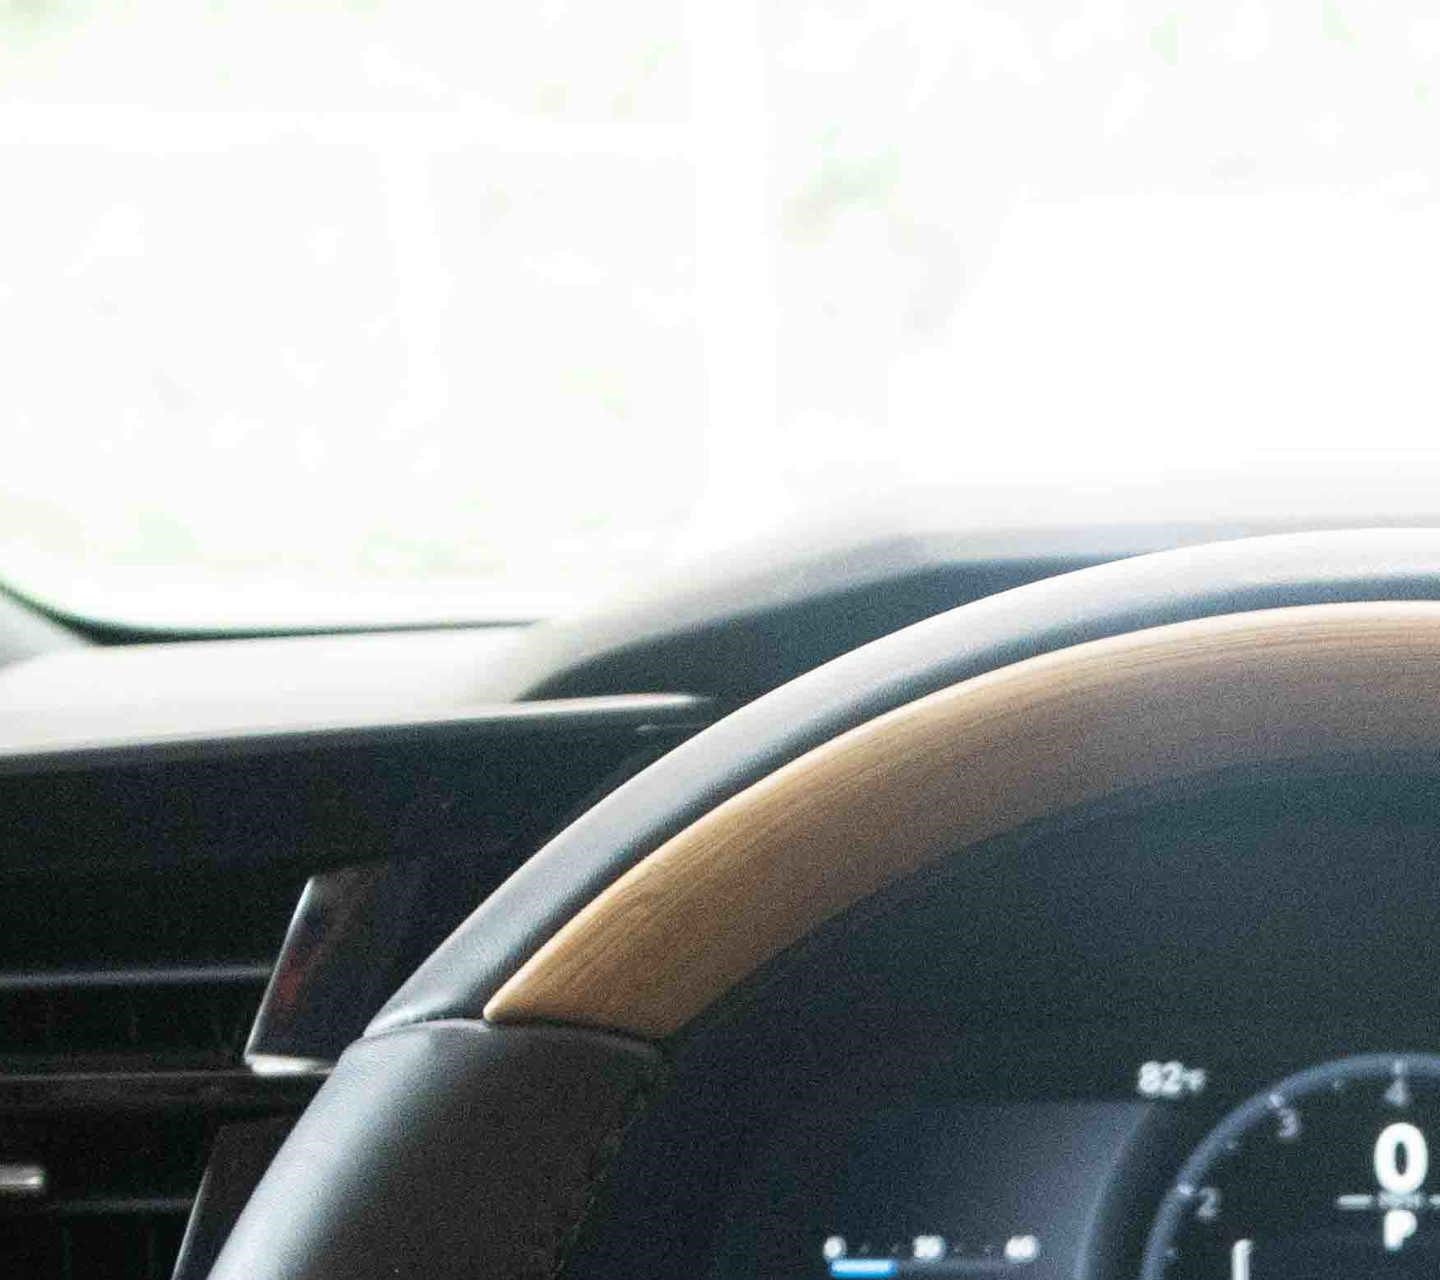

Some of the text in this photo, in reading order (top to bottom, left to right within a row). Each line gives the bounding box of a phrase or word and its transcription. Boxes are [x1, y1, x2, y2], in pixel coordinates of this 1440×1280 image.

[1373, 1121, 1429, 1195] 0
[1197, 1187, 1221, 1220] 2
[1383, 1209, 1419, 1252] P
